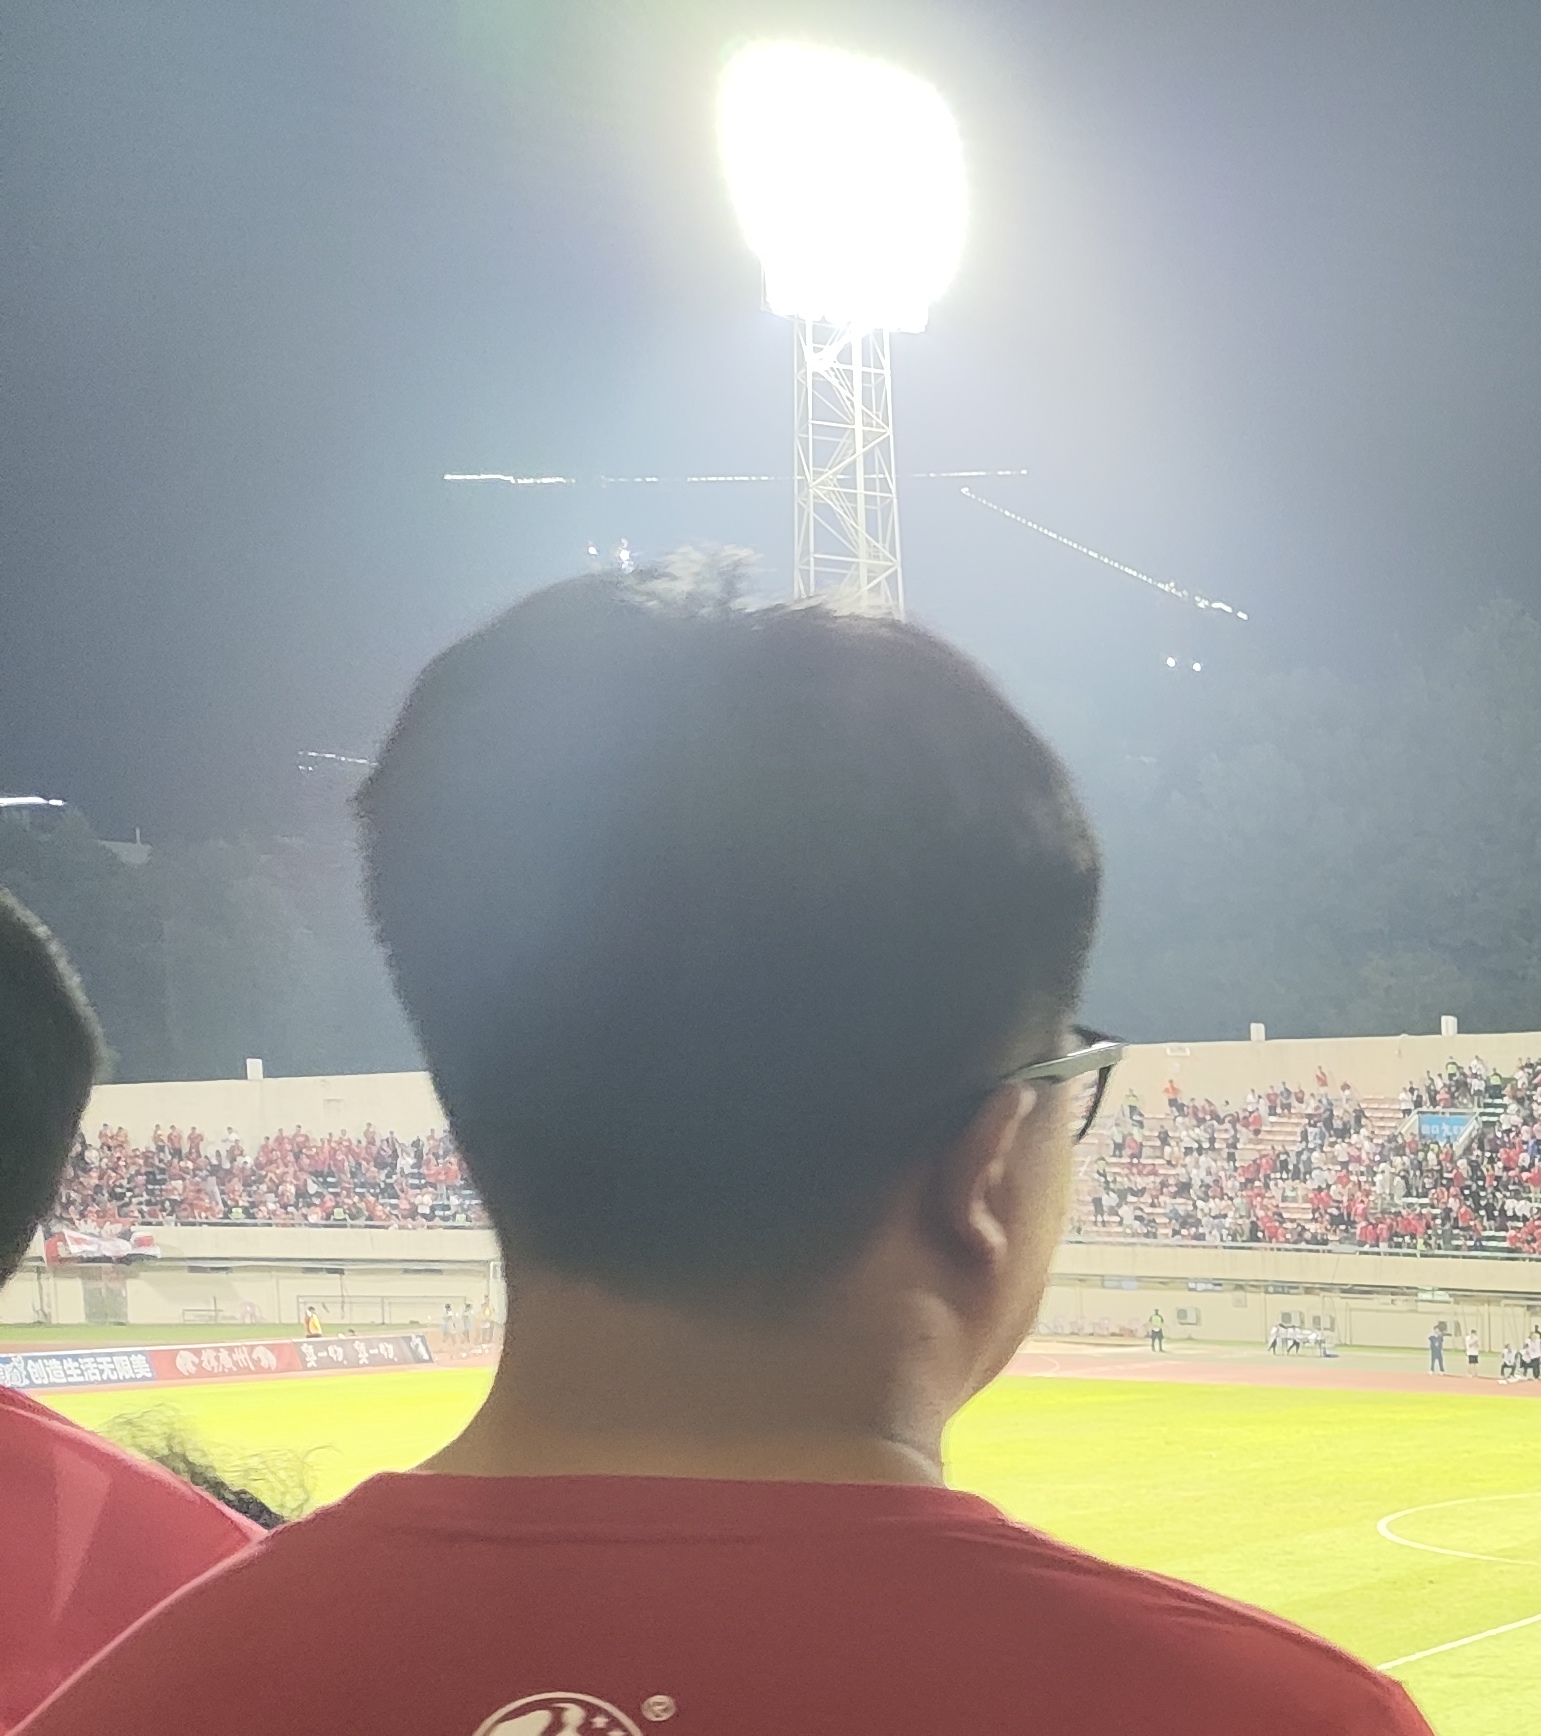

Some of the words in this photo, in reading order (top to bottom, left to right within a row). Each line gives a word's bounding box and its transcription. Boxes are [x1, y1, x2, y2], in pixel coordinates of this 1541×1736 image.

[26, 1353, 153, 1385] 创造生活无限美
